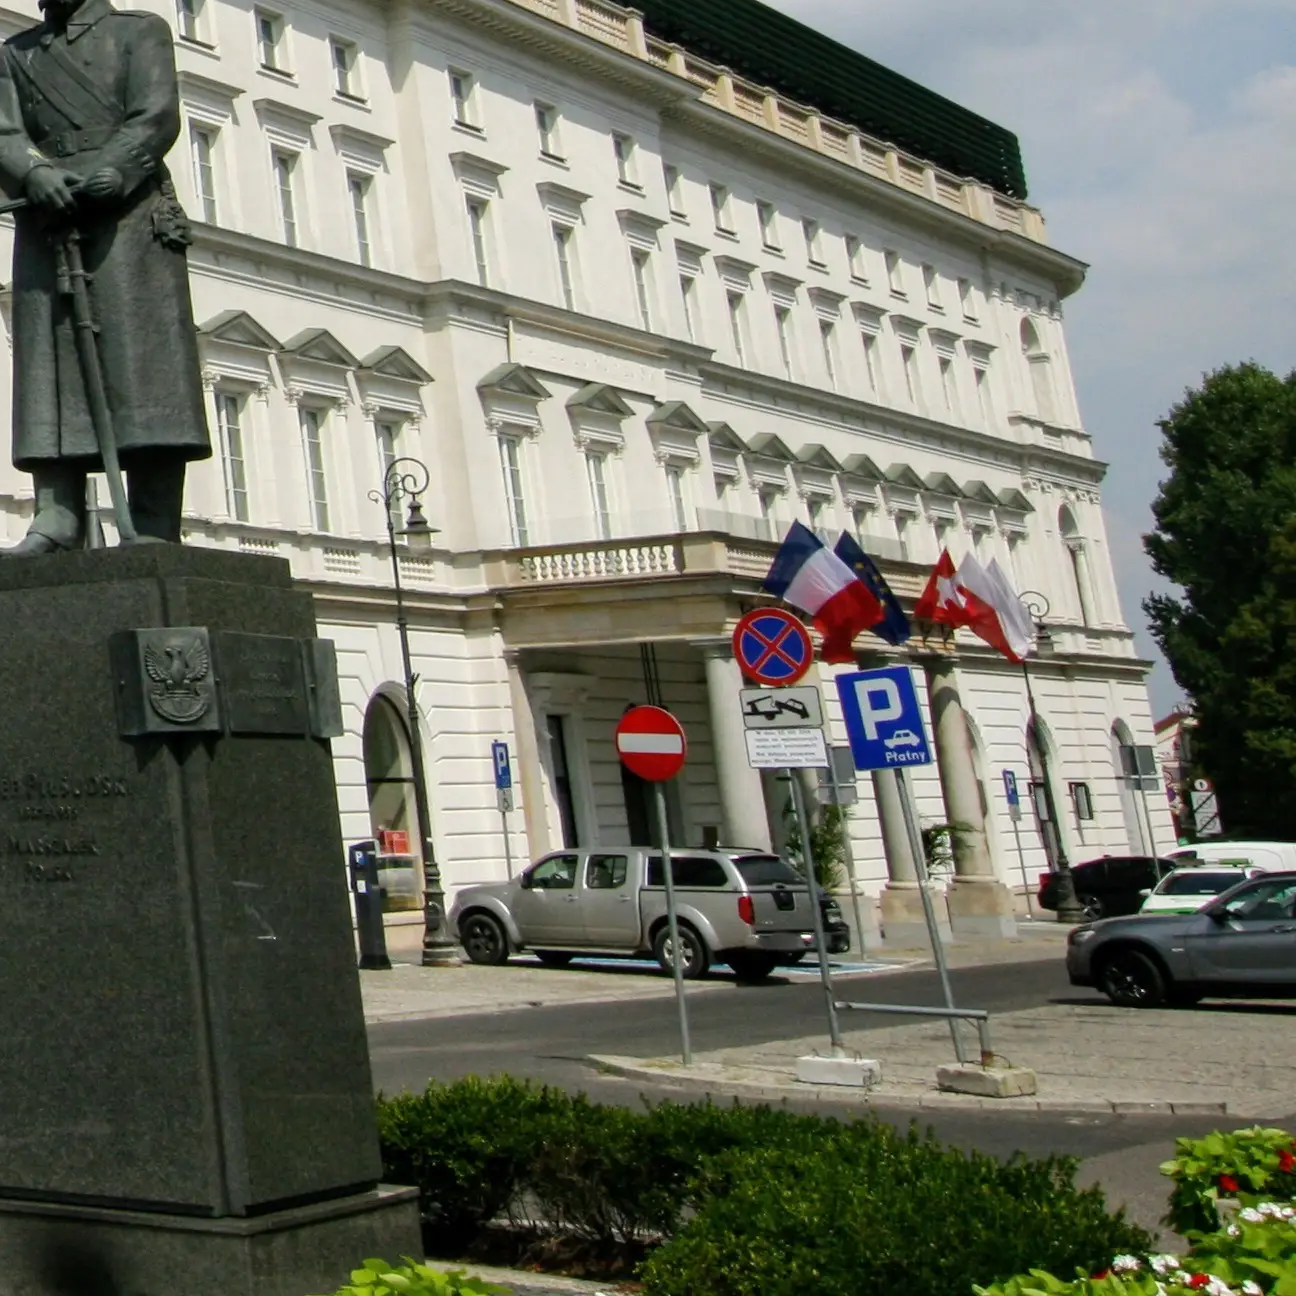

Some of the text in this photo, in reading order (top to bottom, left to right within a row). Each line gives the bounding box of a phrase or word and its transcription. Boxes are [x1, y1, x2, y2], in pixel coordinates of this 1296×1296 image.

[853, 677, 903, 741] P
[495, 746, 508, 776] P
[355, 850, 364, 864] P
